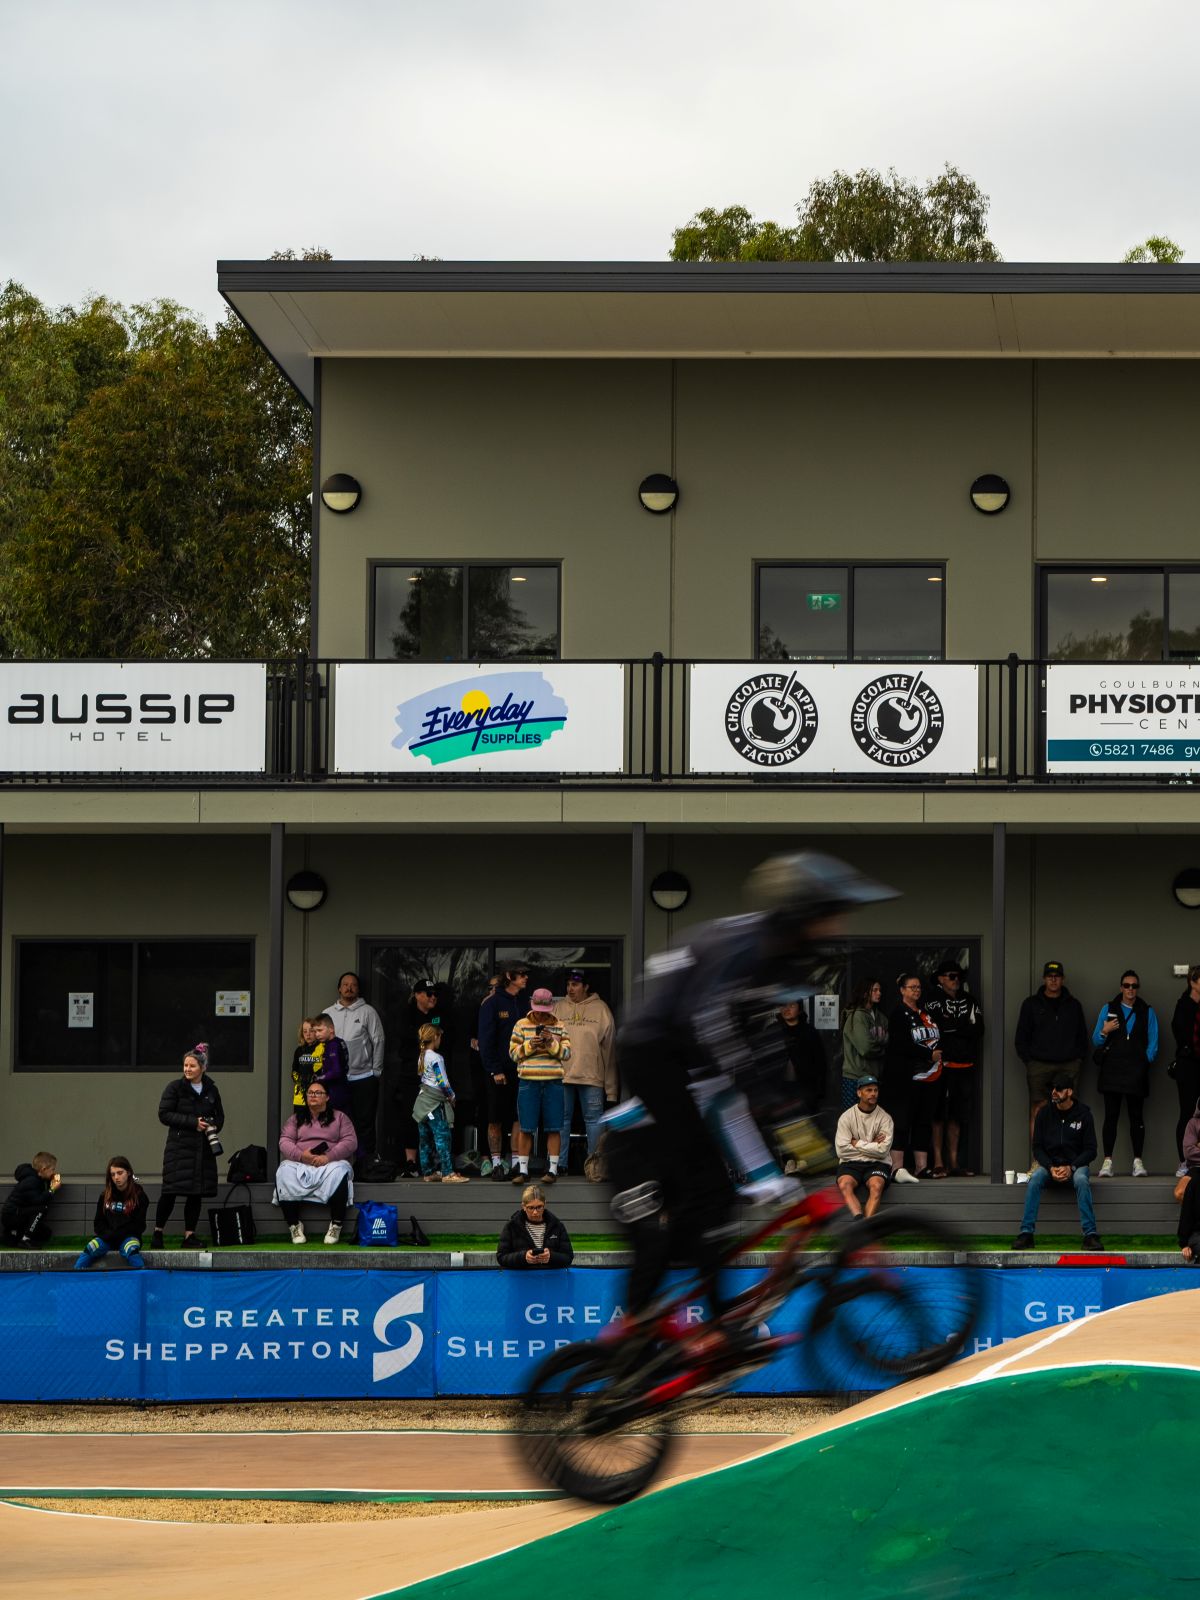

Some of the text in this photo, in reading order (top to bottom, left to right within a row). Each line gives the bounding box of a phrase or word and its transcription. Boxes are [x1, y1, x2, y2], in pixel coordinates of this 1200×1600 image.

[1100, 680, 1200, 689] GOULBURN
[728, 676, 817, 732] CHOCOLATE APPLE
[854, 676, 943, 732] CHOCOLATE APPLE
[420, 692, 535, 752] Everyday
[70, 732, 172, 742] HOTEL
[481, 733, 542, 745] SUPPLIES
[741, 743, 801, 765] FACTORY
[867, 743, 927, 765] FACTORY
[1104, 744, 1136, 756] 5821
[1141, 744, 1174, 756] 7486
[183, 1306, 360, 1328] GREATER
[524, 1303, 705, 1325] GREAR
[105, 1339, 359, 1361] SHEPPARTON
